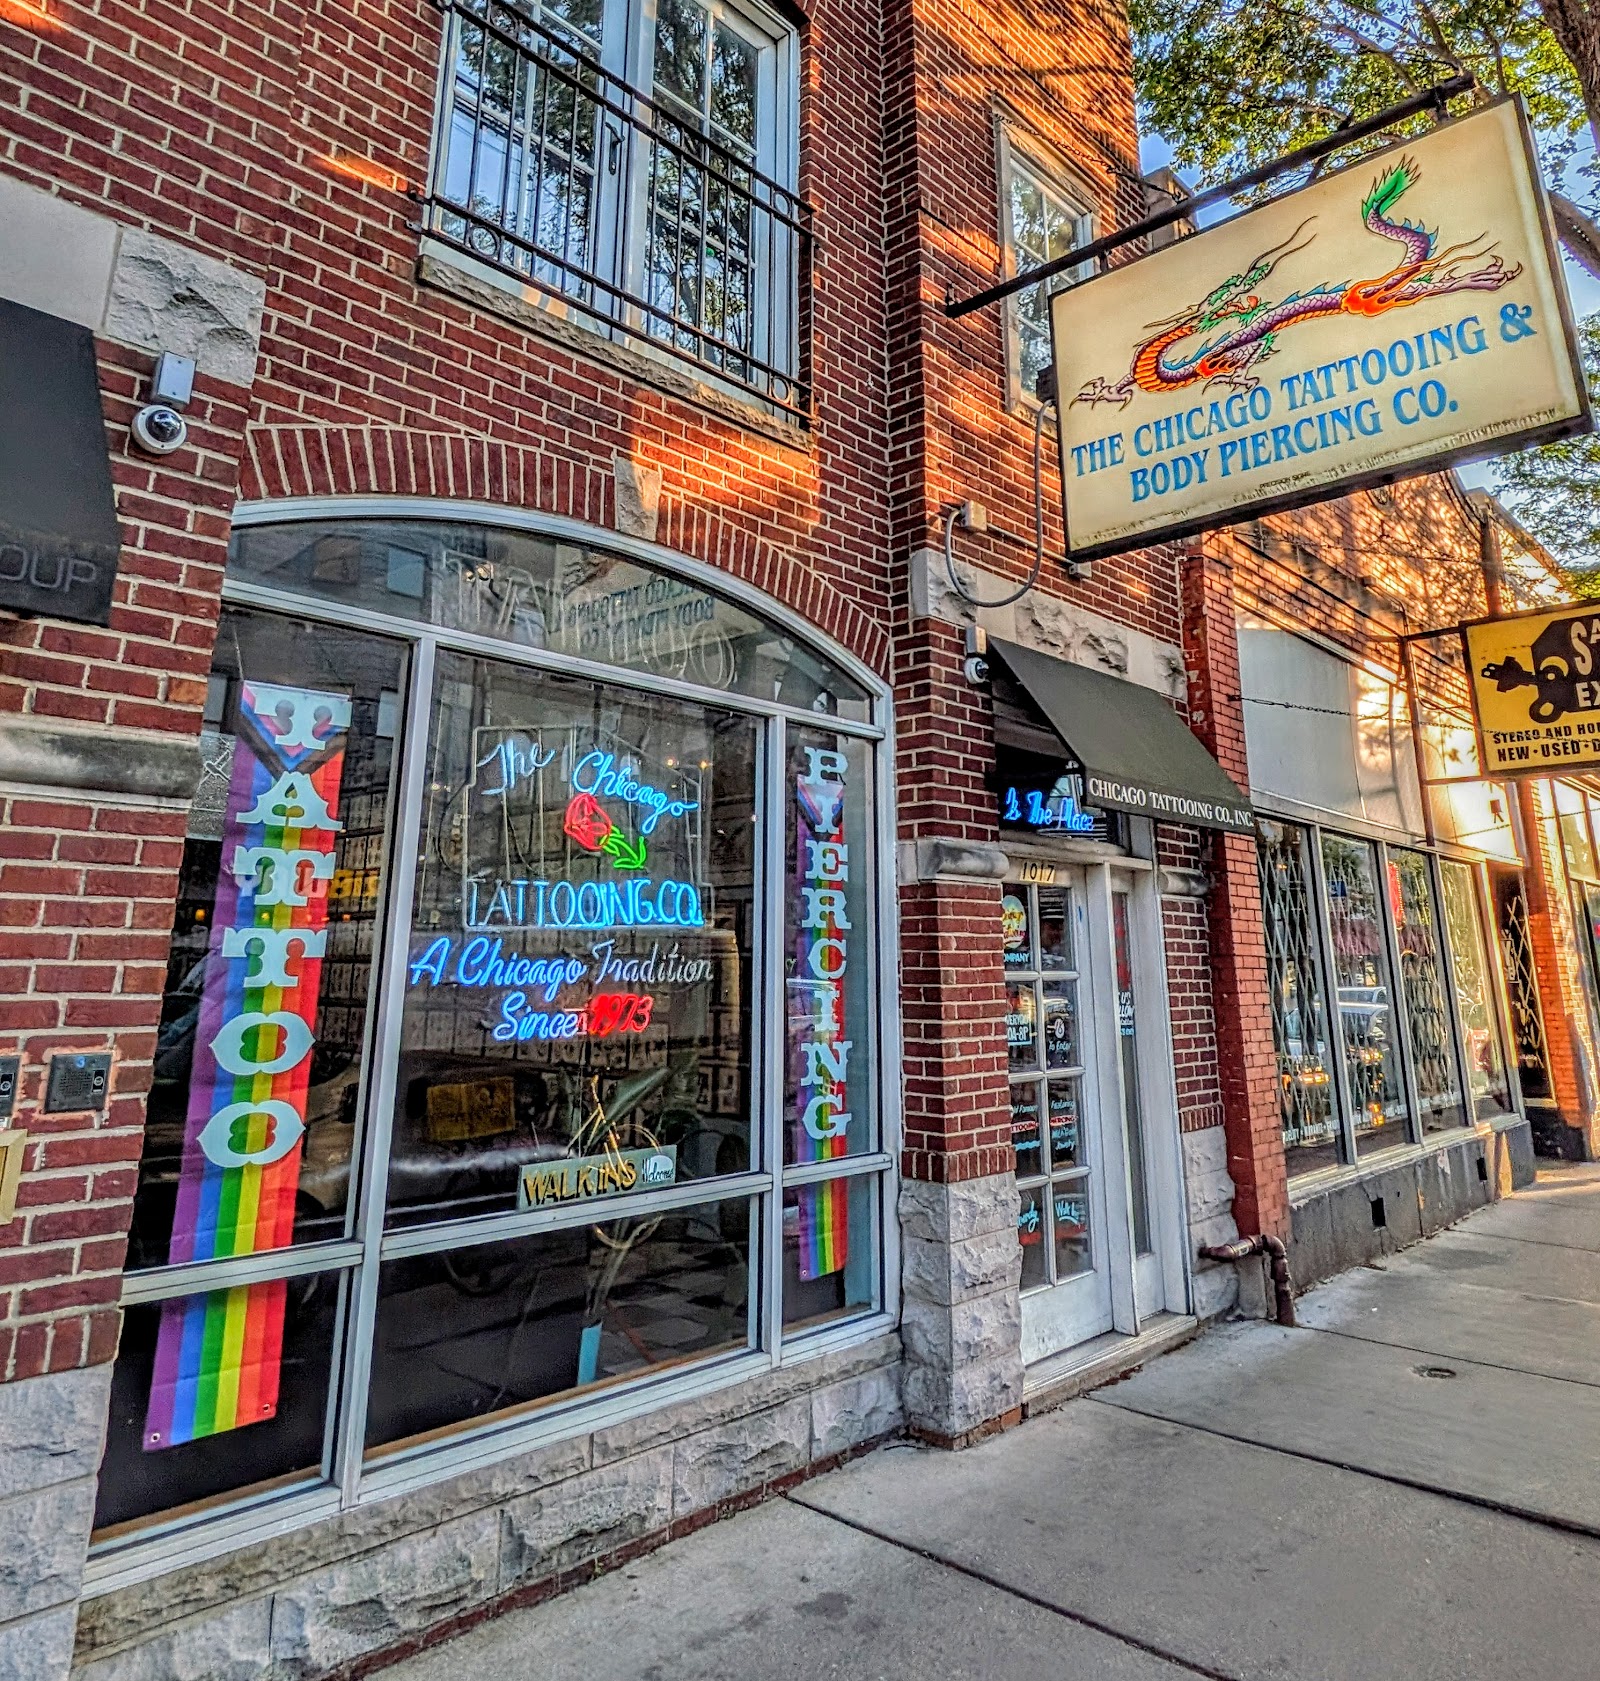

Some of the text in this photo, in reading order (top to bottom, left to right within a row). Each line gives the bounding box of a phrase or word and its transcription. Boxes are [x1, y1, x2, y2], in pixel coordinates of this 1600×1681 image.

[1071, 303, 1538, 477] THE CHICAGO TATTOOING &
[1130, 380, 1459, 502] BODY PIERCING CO.
[1492, 722, 1600, 744] STEREO AND HO
[1497, 746, 1530, 762] NEW
[1540, 740, 1581, 758] USED
[476, 739, 699, 834] The Chicago
[1027, 790, 1053, 825] The
[1089, 778, 1147, 807] CHICAGO
[1149, 791, 1213, 820] TATTOOING
[1234, 809, 1254, 828] INC.
[1021, 862, 1056, 882] 1017
[197, 690, 353, 1168] TATTOO
[801, 747, 853, 1141] PIERCING
[410, 936, 714, 1001] A Chicago Tradition
[1003, 953, 1030, 963] OMPANY
[493, 991, 655, 1042] Since 1973
